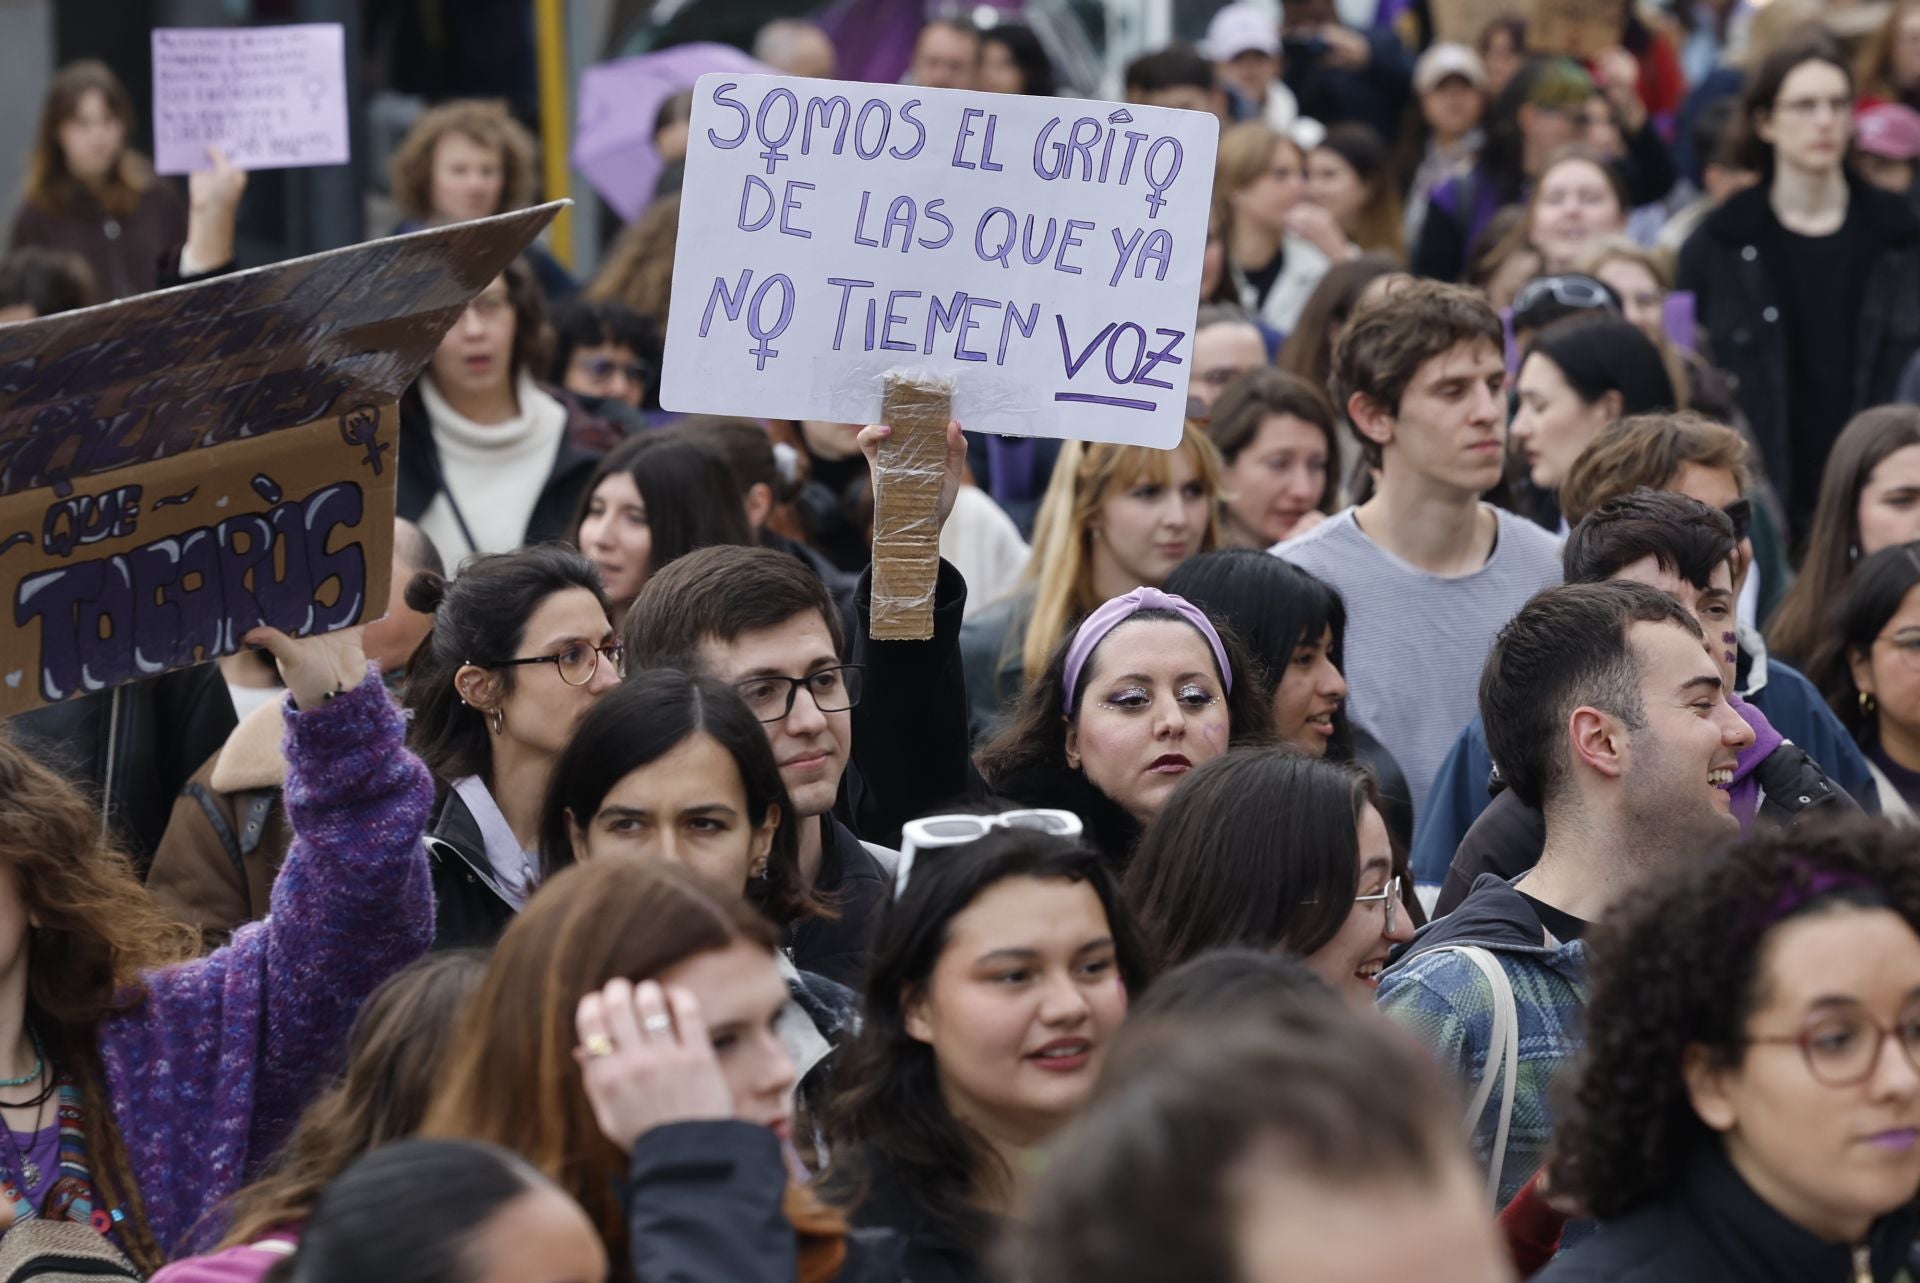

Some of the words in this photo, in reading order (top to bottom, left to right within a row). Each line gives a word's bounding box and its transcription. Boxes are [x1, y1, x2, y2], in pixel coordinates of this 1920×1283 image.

[708, 83, 926, 174] SOMOS
[951, 108, 1004, 171] EL
[737, 175, 816, 239] DE
[854, 190, 954, 253] LAS
[974, 206, 1096, 275] QUE
[1109, 227, 1174, 287] YA
[699, 268, 796, 372] NO
[827, 277, 1041, 366] TIENEN
[1055, 314, 1187, 390] VOZ
[42, 484, 143, 557] QUE
